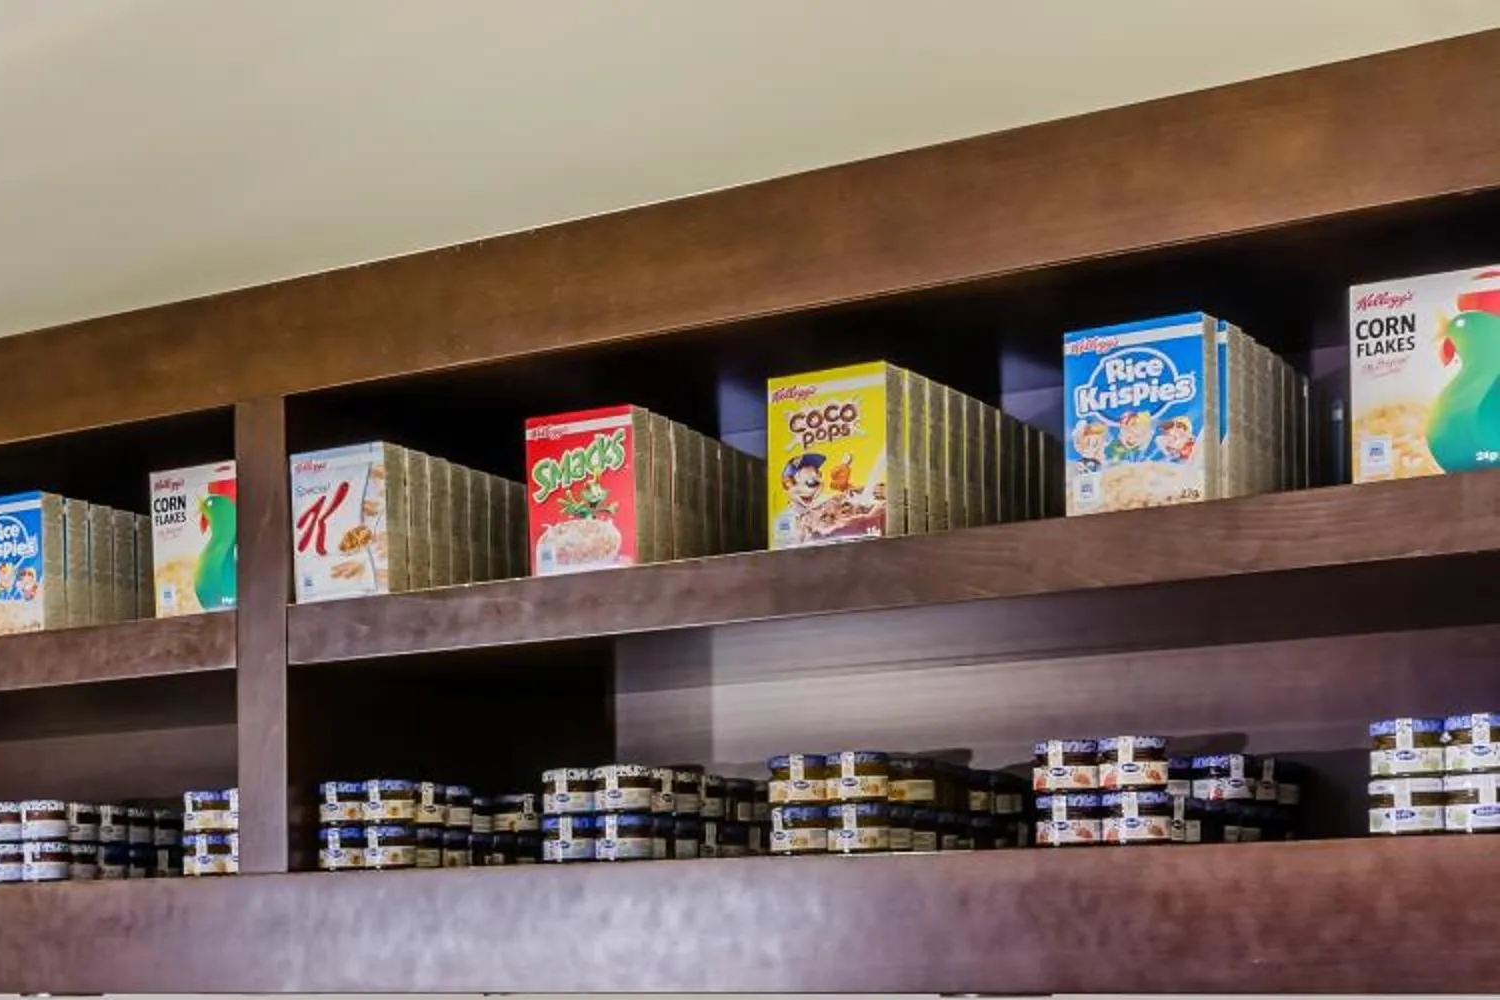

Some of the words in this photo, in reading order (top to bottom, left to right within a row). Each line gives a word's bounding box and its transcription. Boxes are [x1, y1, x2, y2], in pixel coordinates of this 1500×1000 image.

[1355, 313, 1416, 341] CORN
[1356, 335, 1416, 358] FLAKES
[1106, 357, 1164, 383] Rice
[1077, 379, 1193, 412] Krispies
[153, 494, 187, 514] CORN
[154, 511, 187, 527] FLAKES
[296, 481, 350, 556] K
